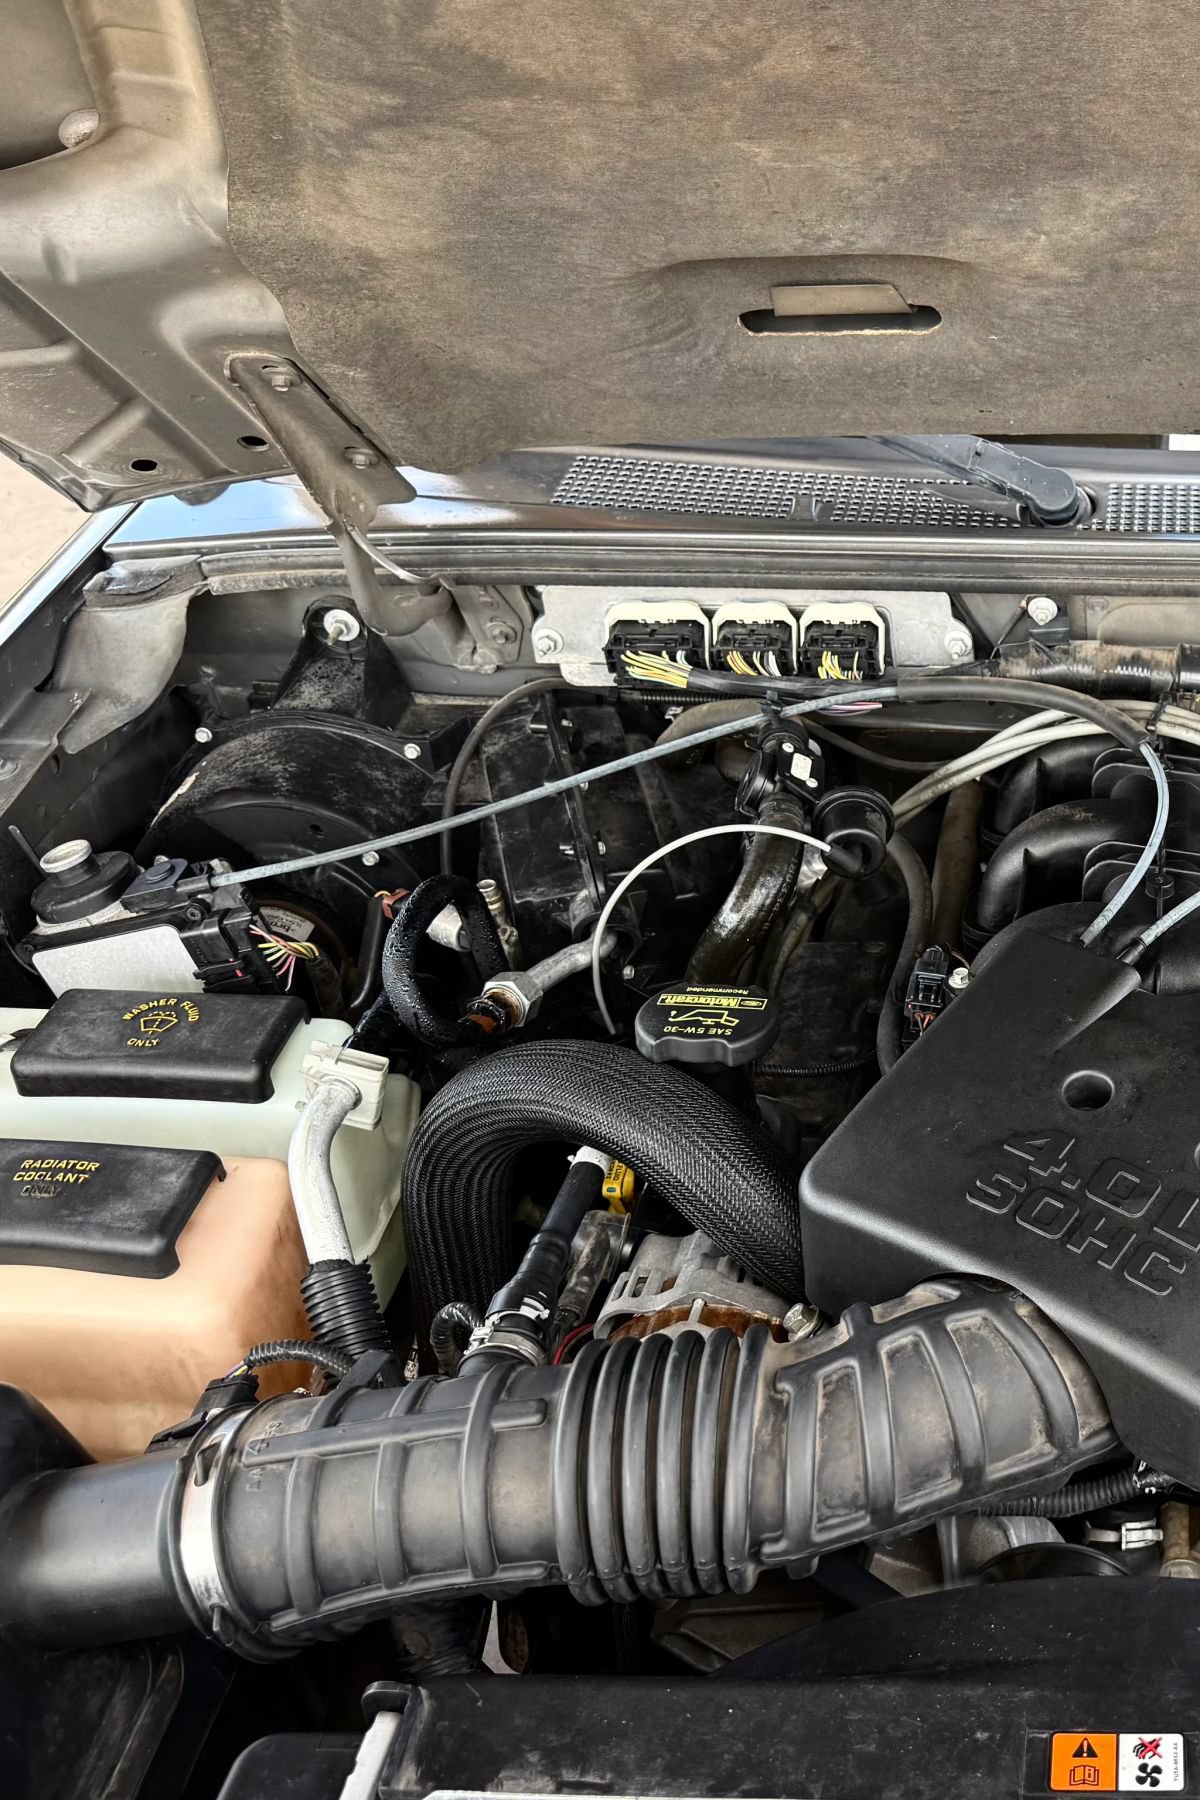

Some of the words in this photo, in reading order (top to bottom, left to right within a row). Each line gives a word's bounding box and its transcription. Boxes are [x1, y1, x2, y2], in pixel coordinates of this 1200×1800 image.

[686, 987, 748, 995] Recommended
[123, 998, 178, 1020] WASHER
[181, 1001, 200, 1023] FLUID
[663, 1025, 705, 1033] 5W-30
[708, 1027, 733, 1035] SAE
[127, 1038, 160, 1047] ONLY
[20, 1159, 100, 1171] RADIATOR
[12, 1171, 89, 1184] COOLANT
[966, 1168, 1186, 1297] SOHC
